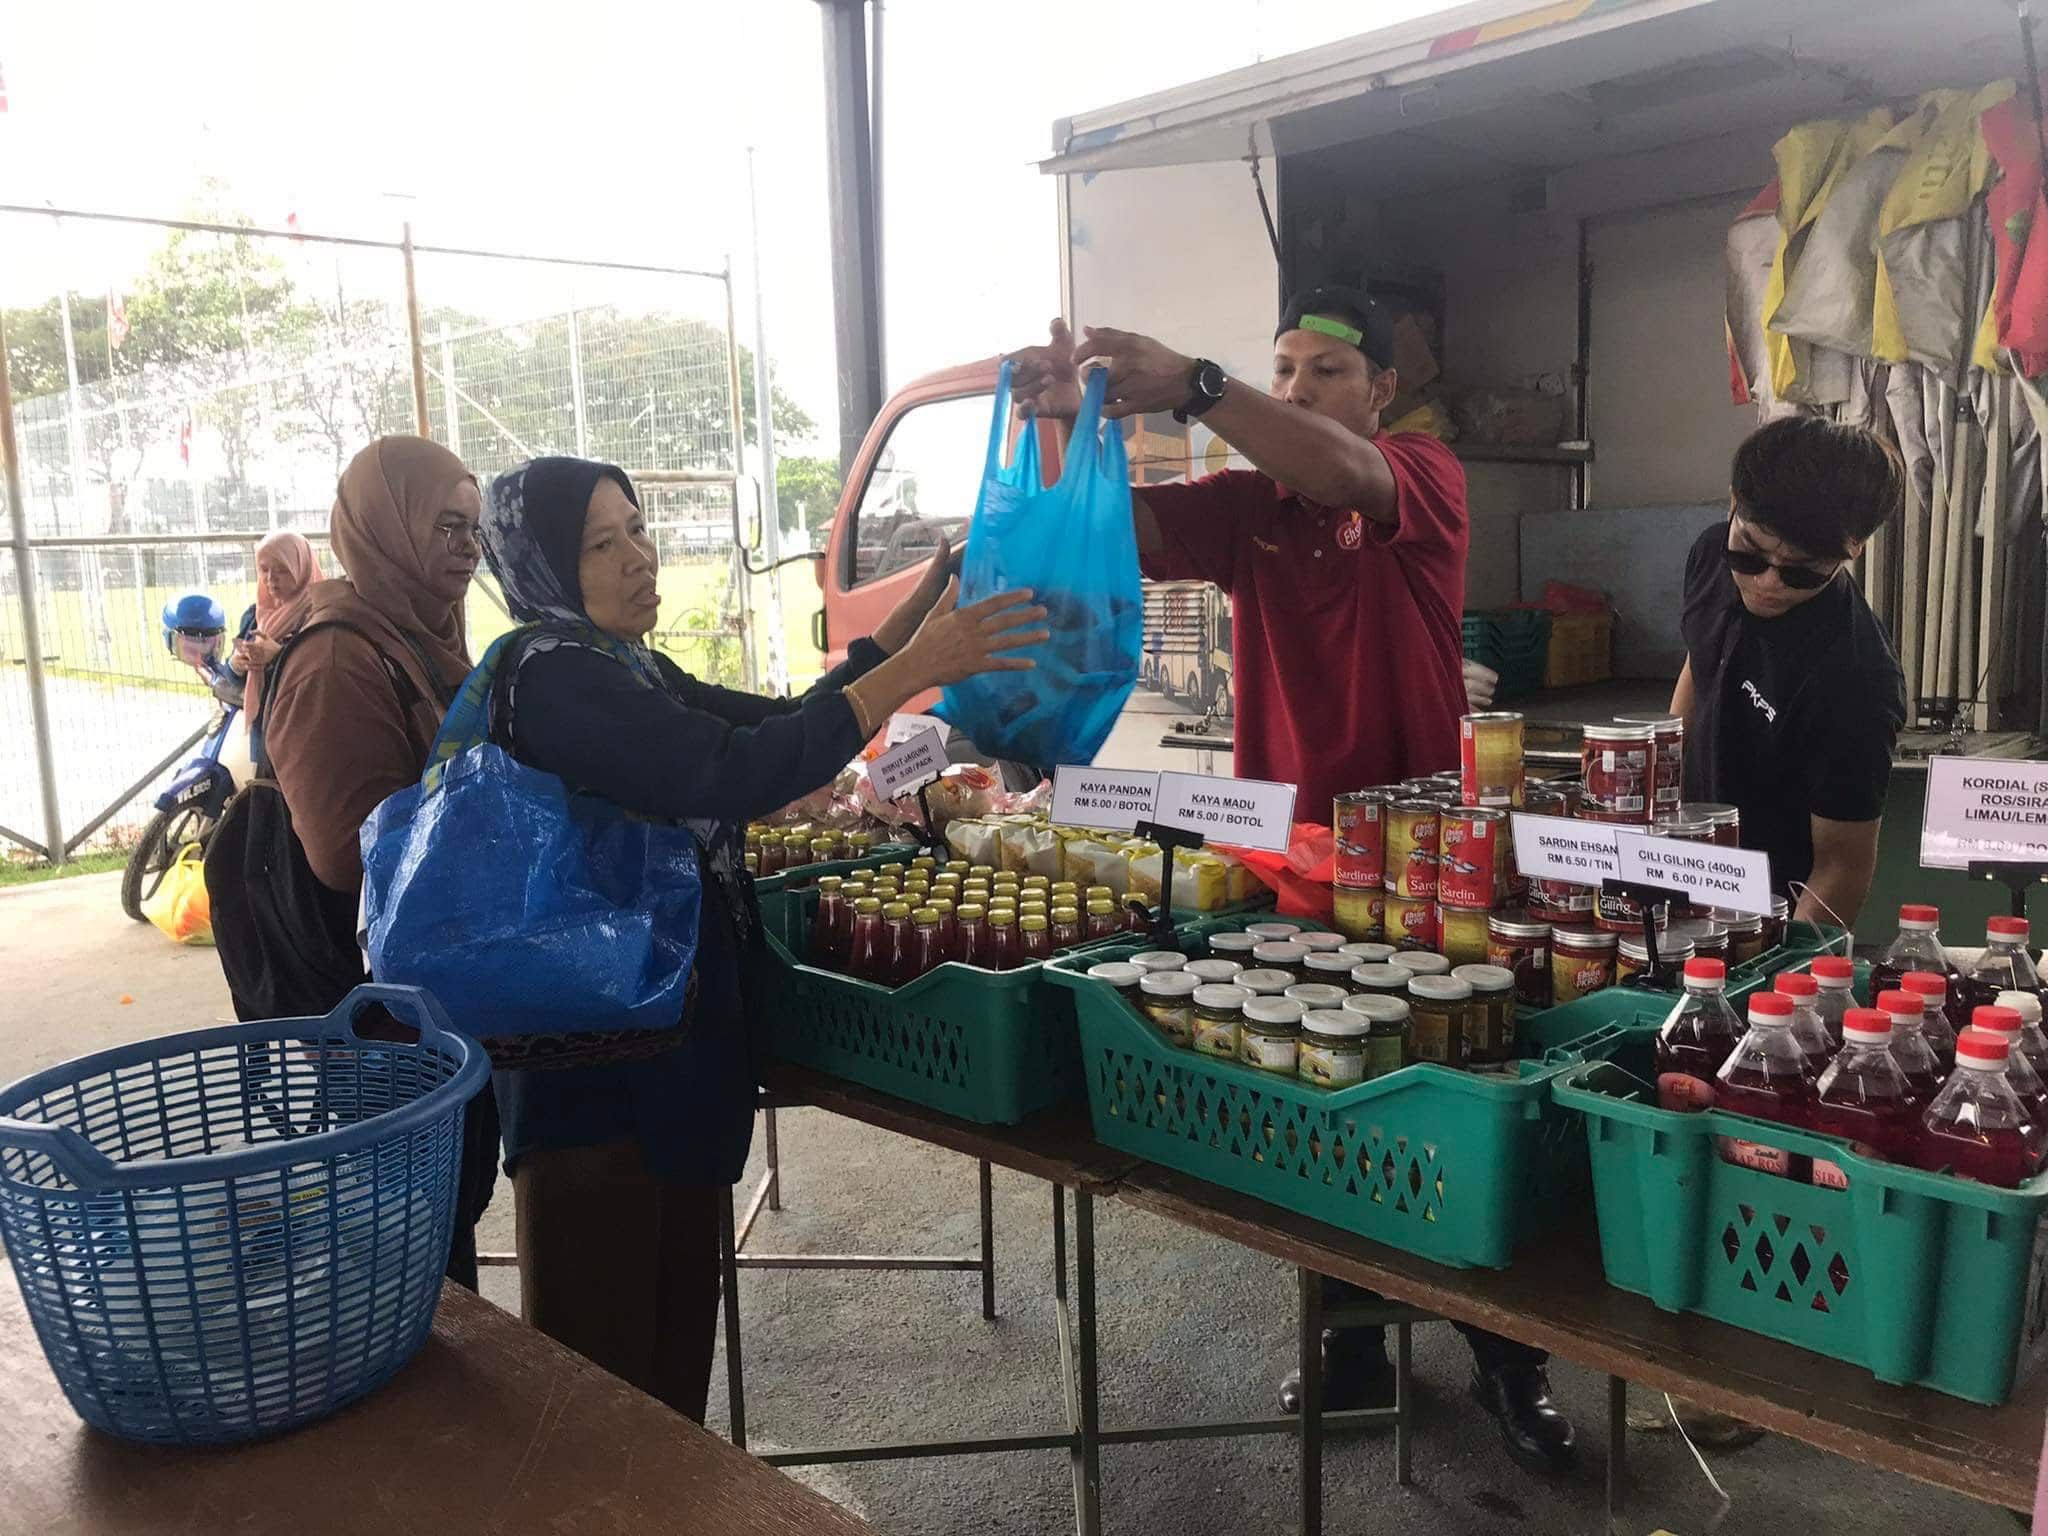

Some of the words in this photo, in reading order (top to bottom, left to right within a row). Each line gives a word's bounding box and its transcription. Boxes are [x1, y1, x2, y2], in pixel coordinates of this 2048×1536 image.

[1741, 679, 1777, 722] PKPS
[916, 755, 934, 770] PACK
[1080, 782, 1107, 793] KAYA
[1109, 784, 1152, 797] PANDAN
[1962, 777, 2029, 791] KORDIAL
[1074, 796, 1089, 807] RM
[1091, 798, 1112, 809] 5.00
[1118, 800, 1153, 812] BOTOL
[1191, 793, 1220, 806] KAYA
[1222, 797, 1256, 810] MADU
[1178, 808, 1195, 818] RM
[1196, 810, 1219, 821] 5.00
[1226, 814, 1264, 827] BOTOL
[1965, 808, 2048, 823] LIMAU/LEM
[1538, 836, 1578, 850] SARDIN
[1580, 841, 1618, 855] EHSAN
[1547, 853, 1564, 864] RM
[1565, 855, 1587, 867] 6.50
[1595, 859, 1613, 870] TIN
[1638, 849, 1661, 861] CILI
[1663, 854, 1705, 870] GILING
[1707, 861, 1746, 879] (400g)
[1336, 867, 1380, 882] Sardines
[1646, 867, 1664, 879] RM
[1672, 872, 1697, 886] 6.00
[1705, 878, 1741, 893] PACK
[1441, 885, 1476, 900] Sardin
[1599, 898, 1631, 914] Giling
